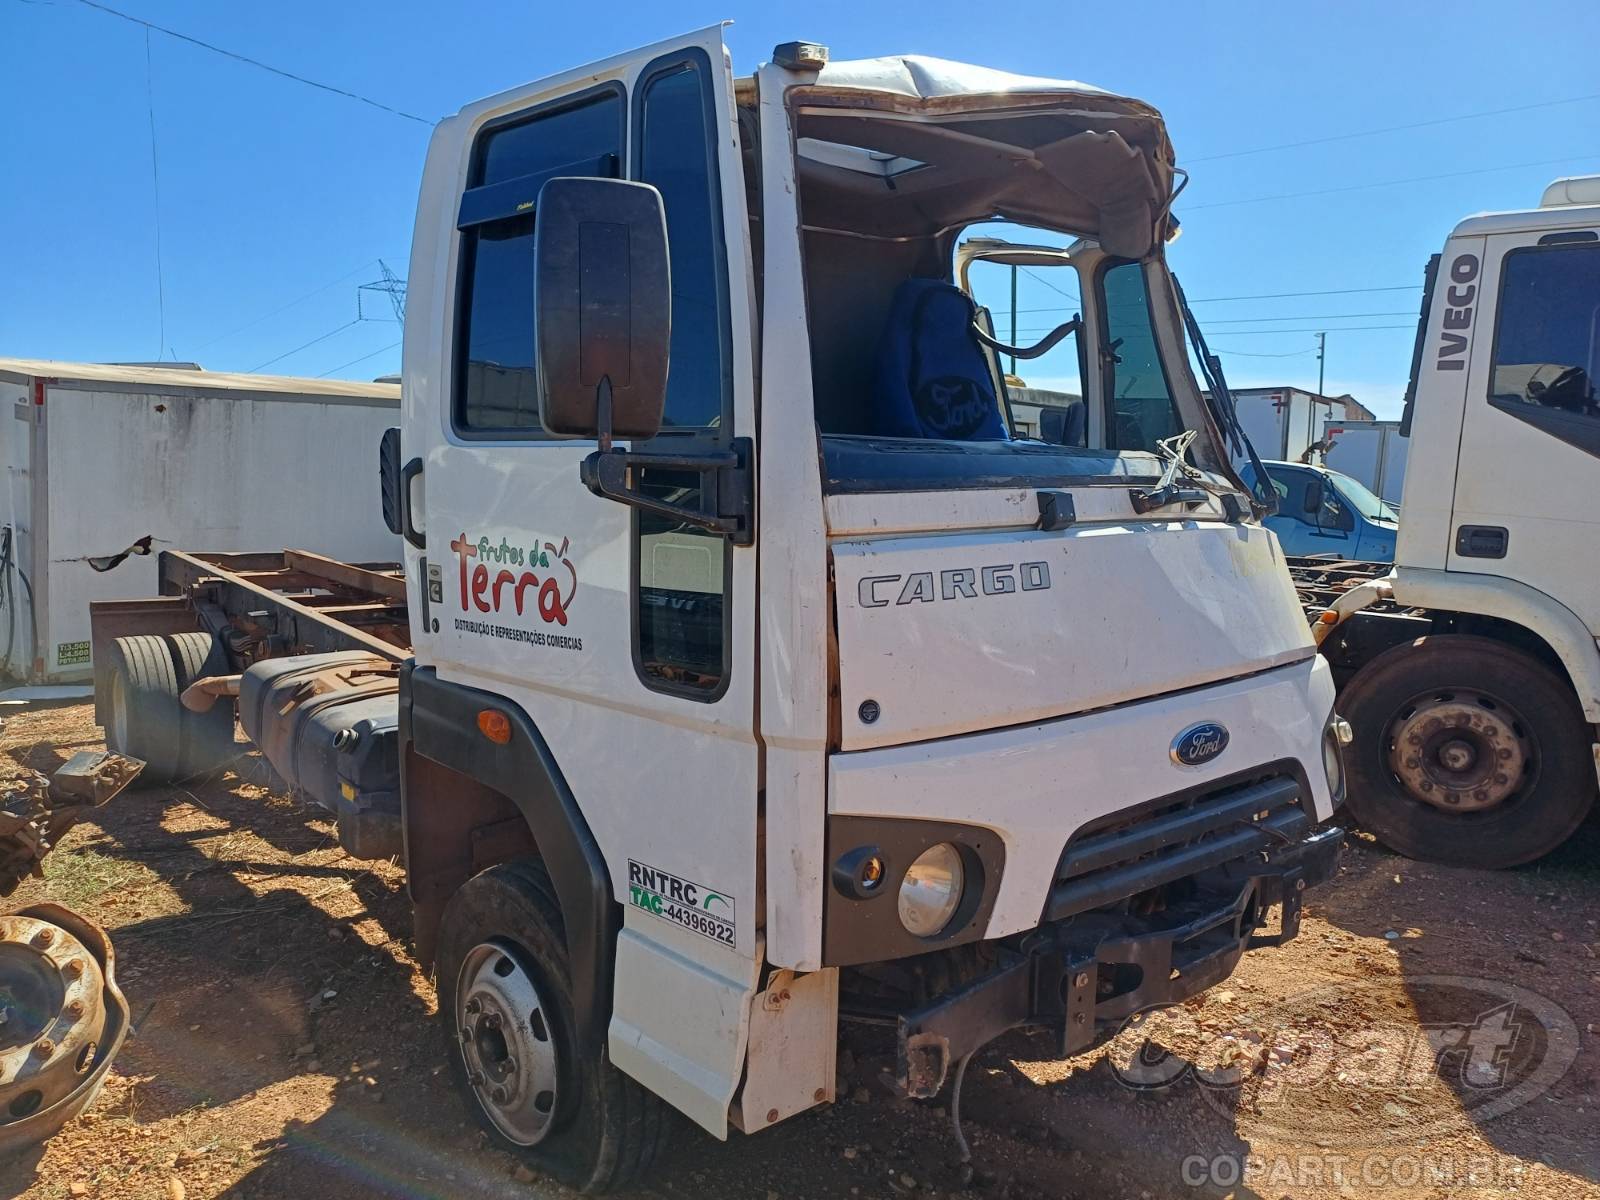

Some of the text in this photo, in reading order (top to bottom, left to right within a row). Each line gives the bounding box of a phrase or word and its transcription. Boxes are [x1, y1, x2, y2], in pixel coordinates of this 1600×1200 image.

[1437, 254, 1479, 370] IVECO
[478, 536, 550, 568] frutos da
[858, 561, 1051, 609] CARGO
[454, 618, 583, 651] DISTRIBUIÇÃO E REPRESENTAÇÕES COMERCIAS
[1189, 730, 1221, 759] Ford
[629, 861, 698, 906] RNTRC
[629, 885, 734, 945] TAC-44396922
